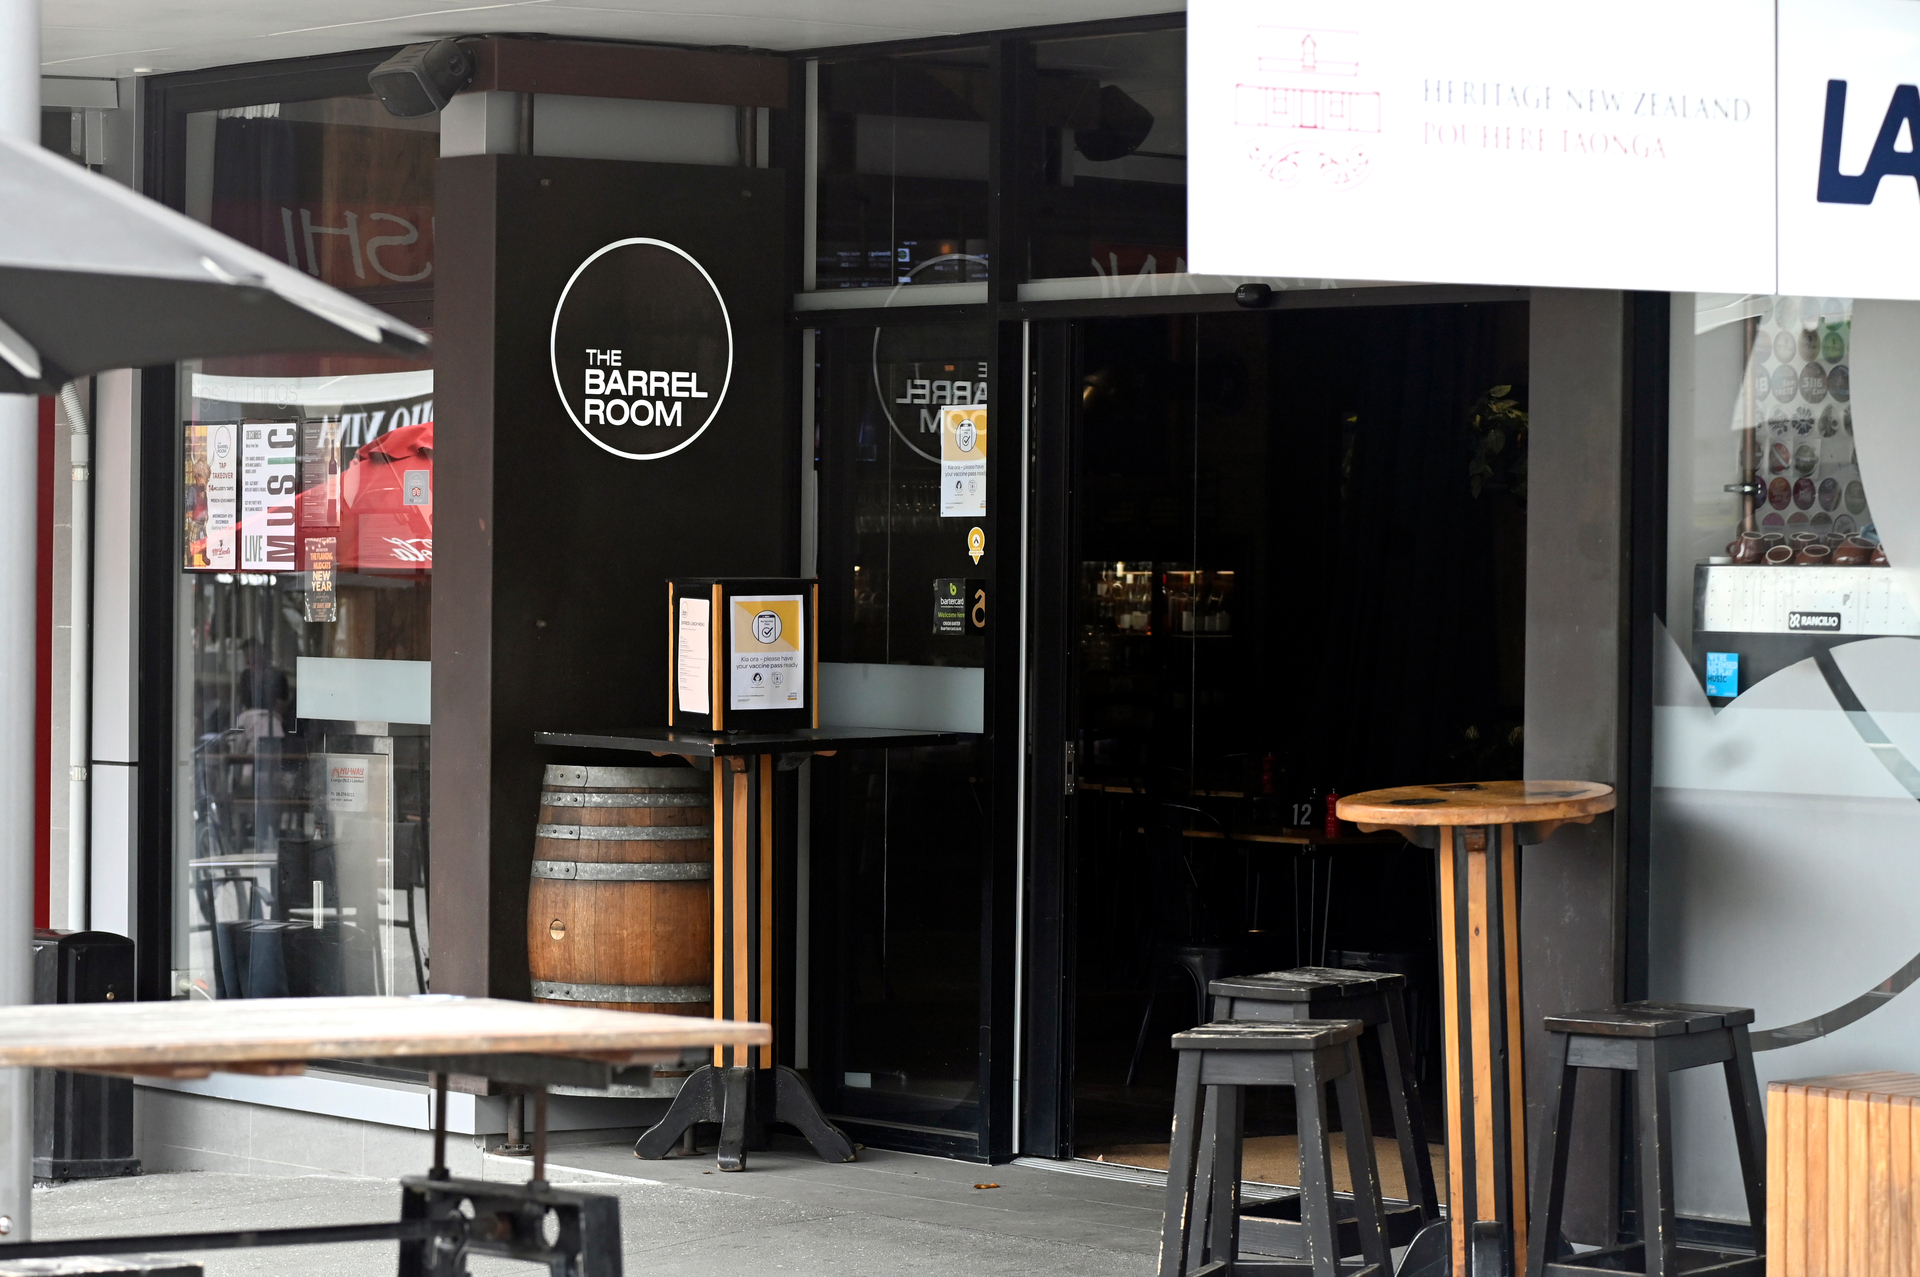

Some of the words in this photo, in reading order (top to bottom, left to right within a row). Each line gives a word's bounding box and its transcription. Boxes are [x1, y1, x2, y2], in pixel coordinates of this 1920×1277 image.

[1425, 79, 1553, 109] HERITAGE
[1566, 88, 1624, 113] NEW
[1633, 92, 1751, 123] ZEALAND
[1560, 130, 1666, 160] TAONGA
[586, 349, 622, 366] THE
[585, 369, 708, 398] BARREL
[585, 398, 682, 427] ROOM
[208, 484, 214, 492] 14
[267, 428, 297, 562] MUSIC
[245, 535, 263, 562] LIVE
[312, 570, 331, 581] NEW
[311, 581, 332, 592] YEAR
[940, 597, 964, 605] bartercard
[1801, 615, 1838, 627] RANCILIO
[1707, 675, 1728, 683] MUSIC
[1292, 803, 1312, 825] 12
